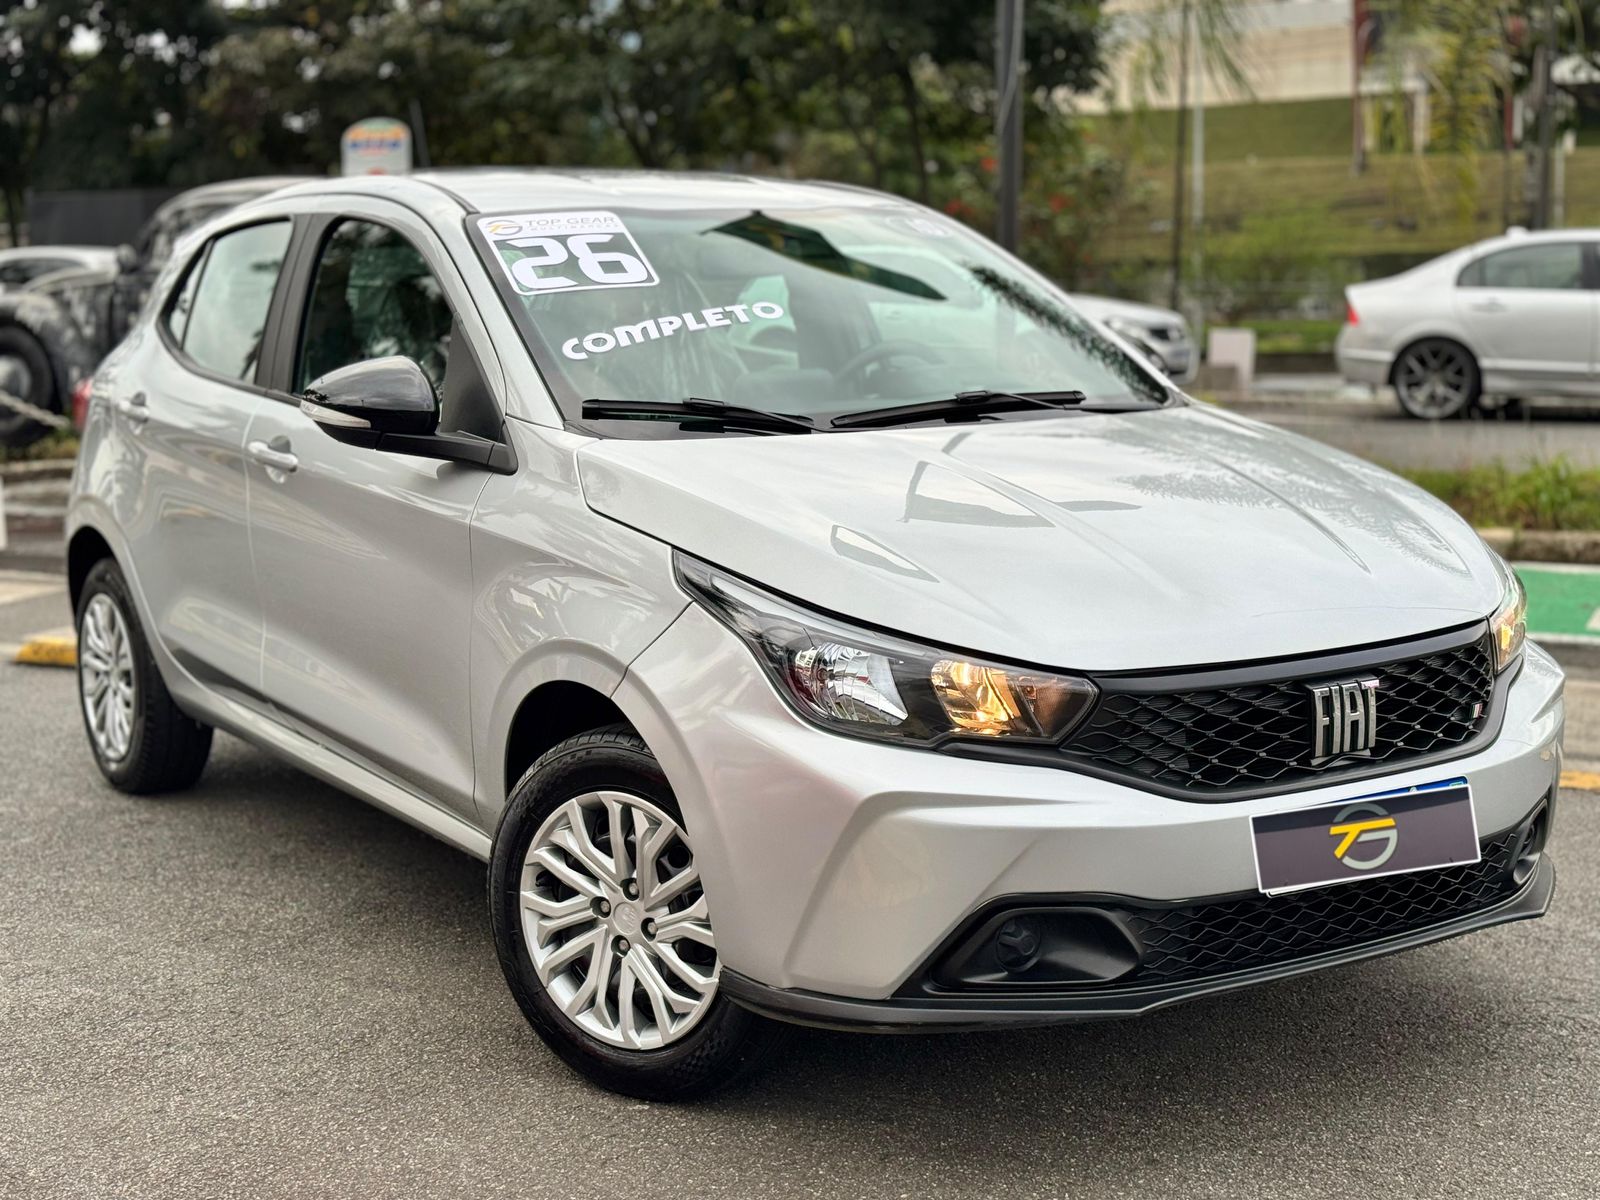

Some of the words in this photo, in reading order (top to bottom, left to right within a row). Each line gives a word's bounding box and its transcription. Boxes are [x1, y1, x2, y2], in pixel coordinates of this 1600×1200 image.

[526, 217, 560, 226] TOP
[567, 215, 615, 225] GEAR
[505, 234, 648, 289] 26
[562, 301, 784, 360] COMPLETO
[1312, 679, 1380, 758] FIAT
